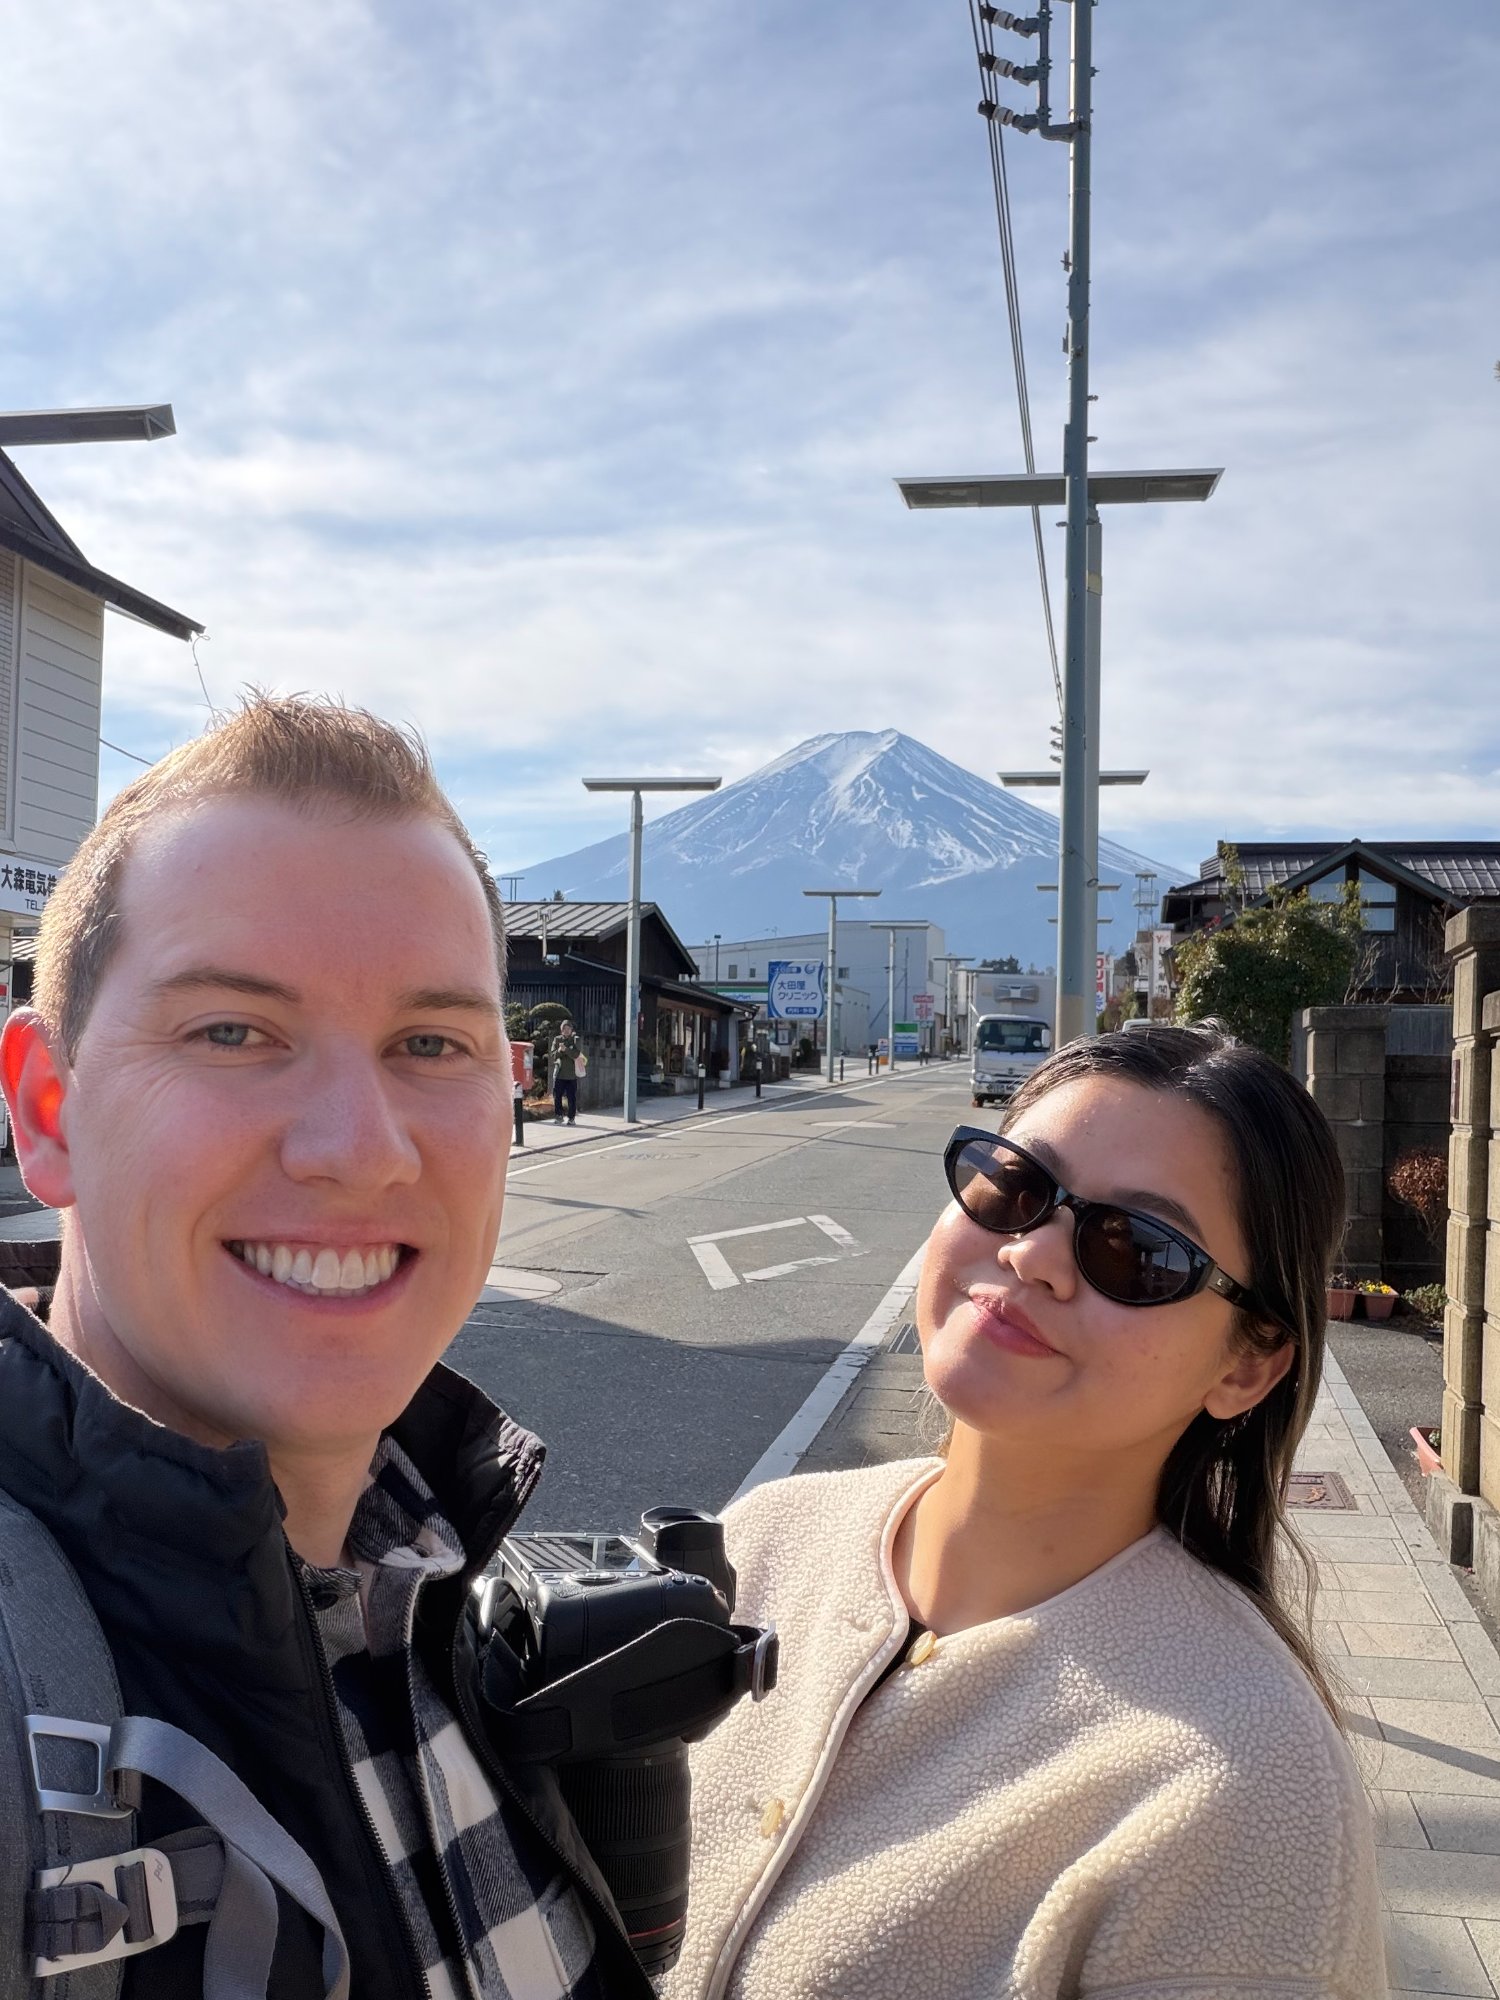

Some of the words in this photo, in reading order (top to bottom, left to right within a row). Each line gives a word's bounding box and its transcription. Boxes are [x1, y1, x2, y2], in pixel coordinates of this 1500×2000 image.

[777, 980, 806, 991] 大田屋
[778, 991, 818, 1001] クリニック
